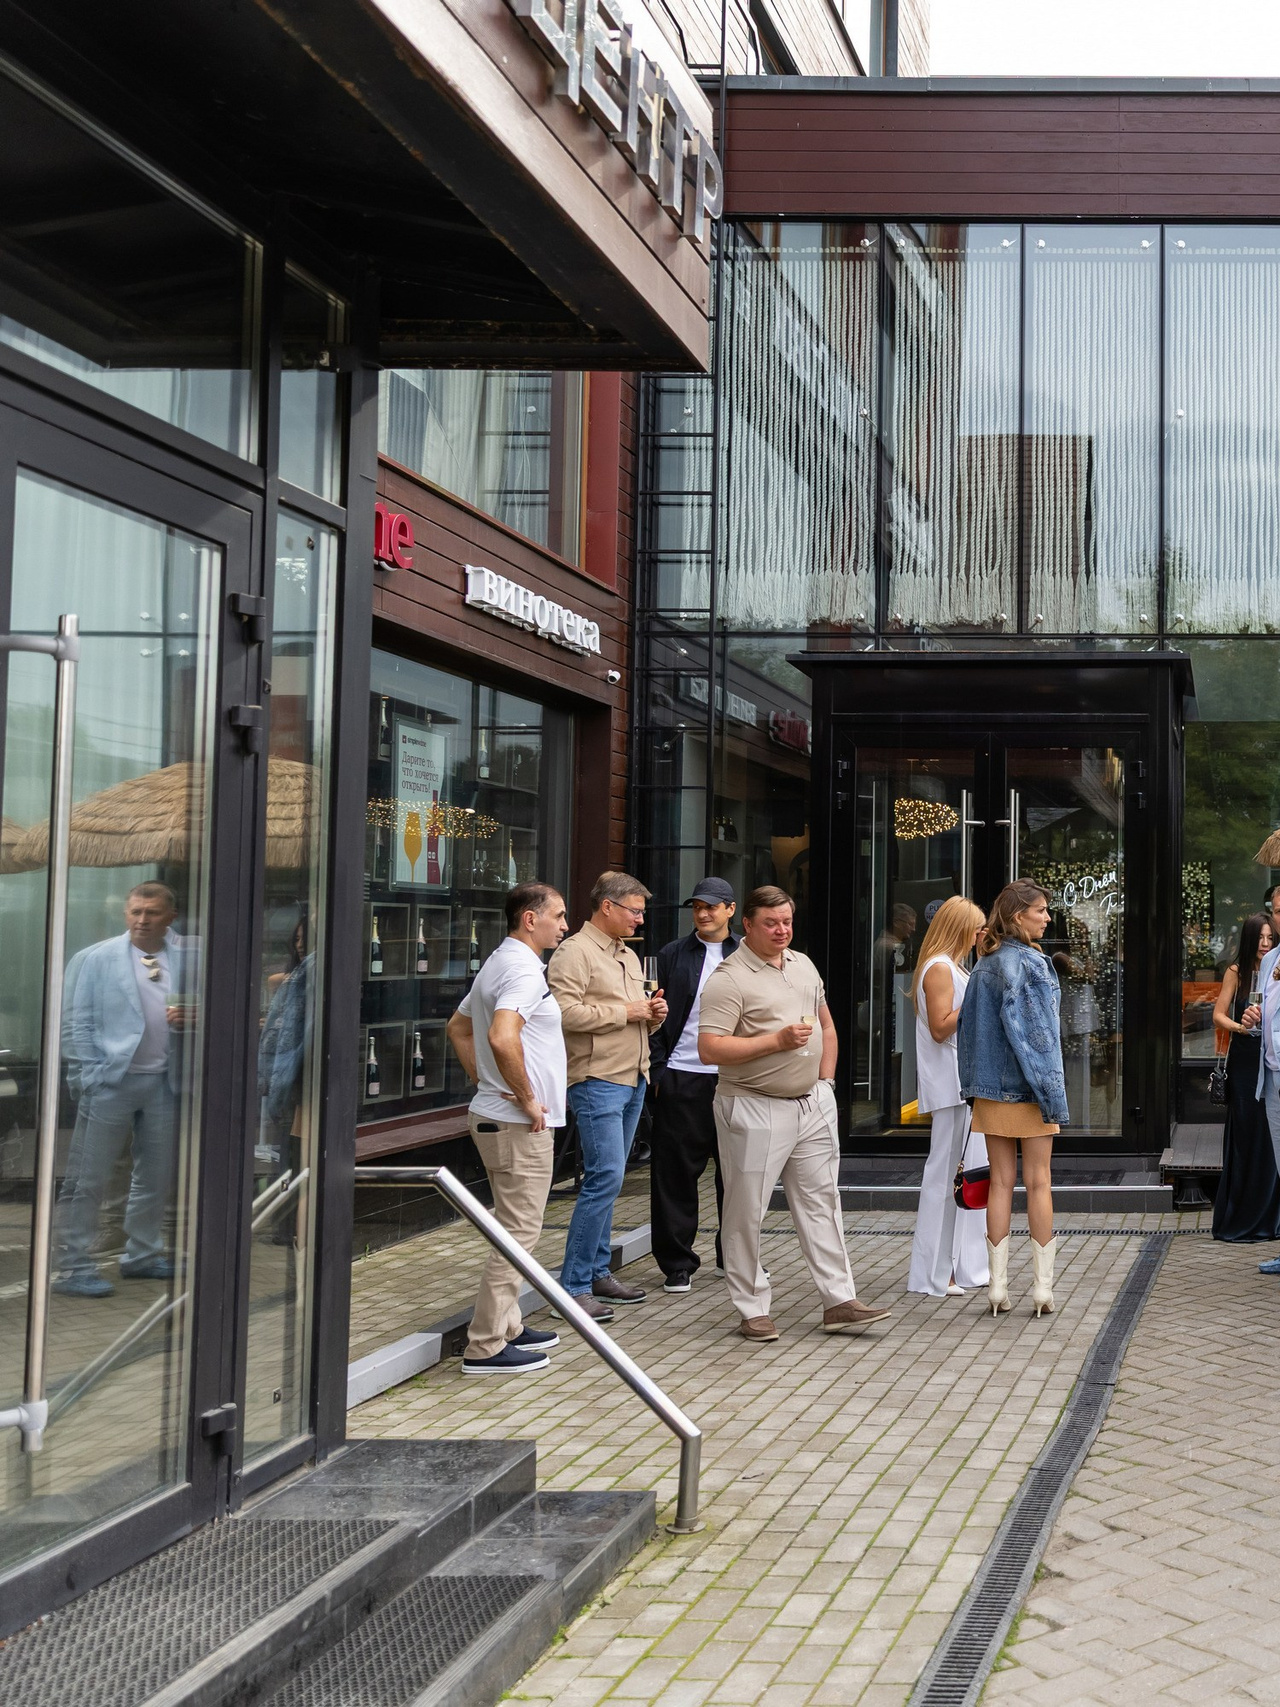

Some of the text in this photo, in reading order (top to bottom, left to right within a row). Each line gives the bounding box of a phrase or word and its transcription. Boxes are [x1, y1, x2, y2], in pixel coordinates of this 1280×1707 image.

[402, 751, 436, 771] Дарите то,
[402, 767, 439, 783] что хочется
[402, 780, 431, 793] открыть!
